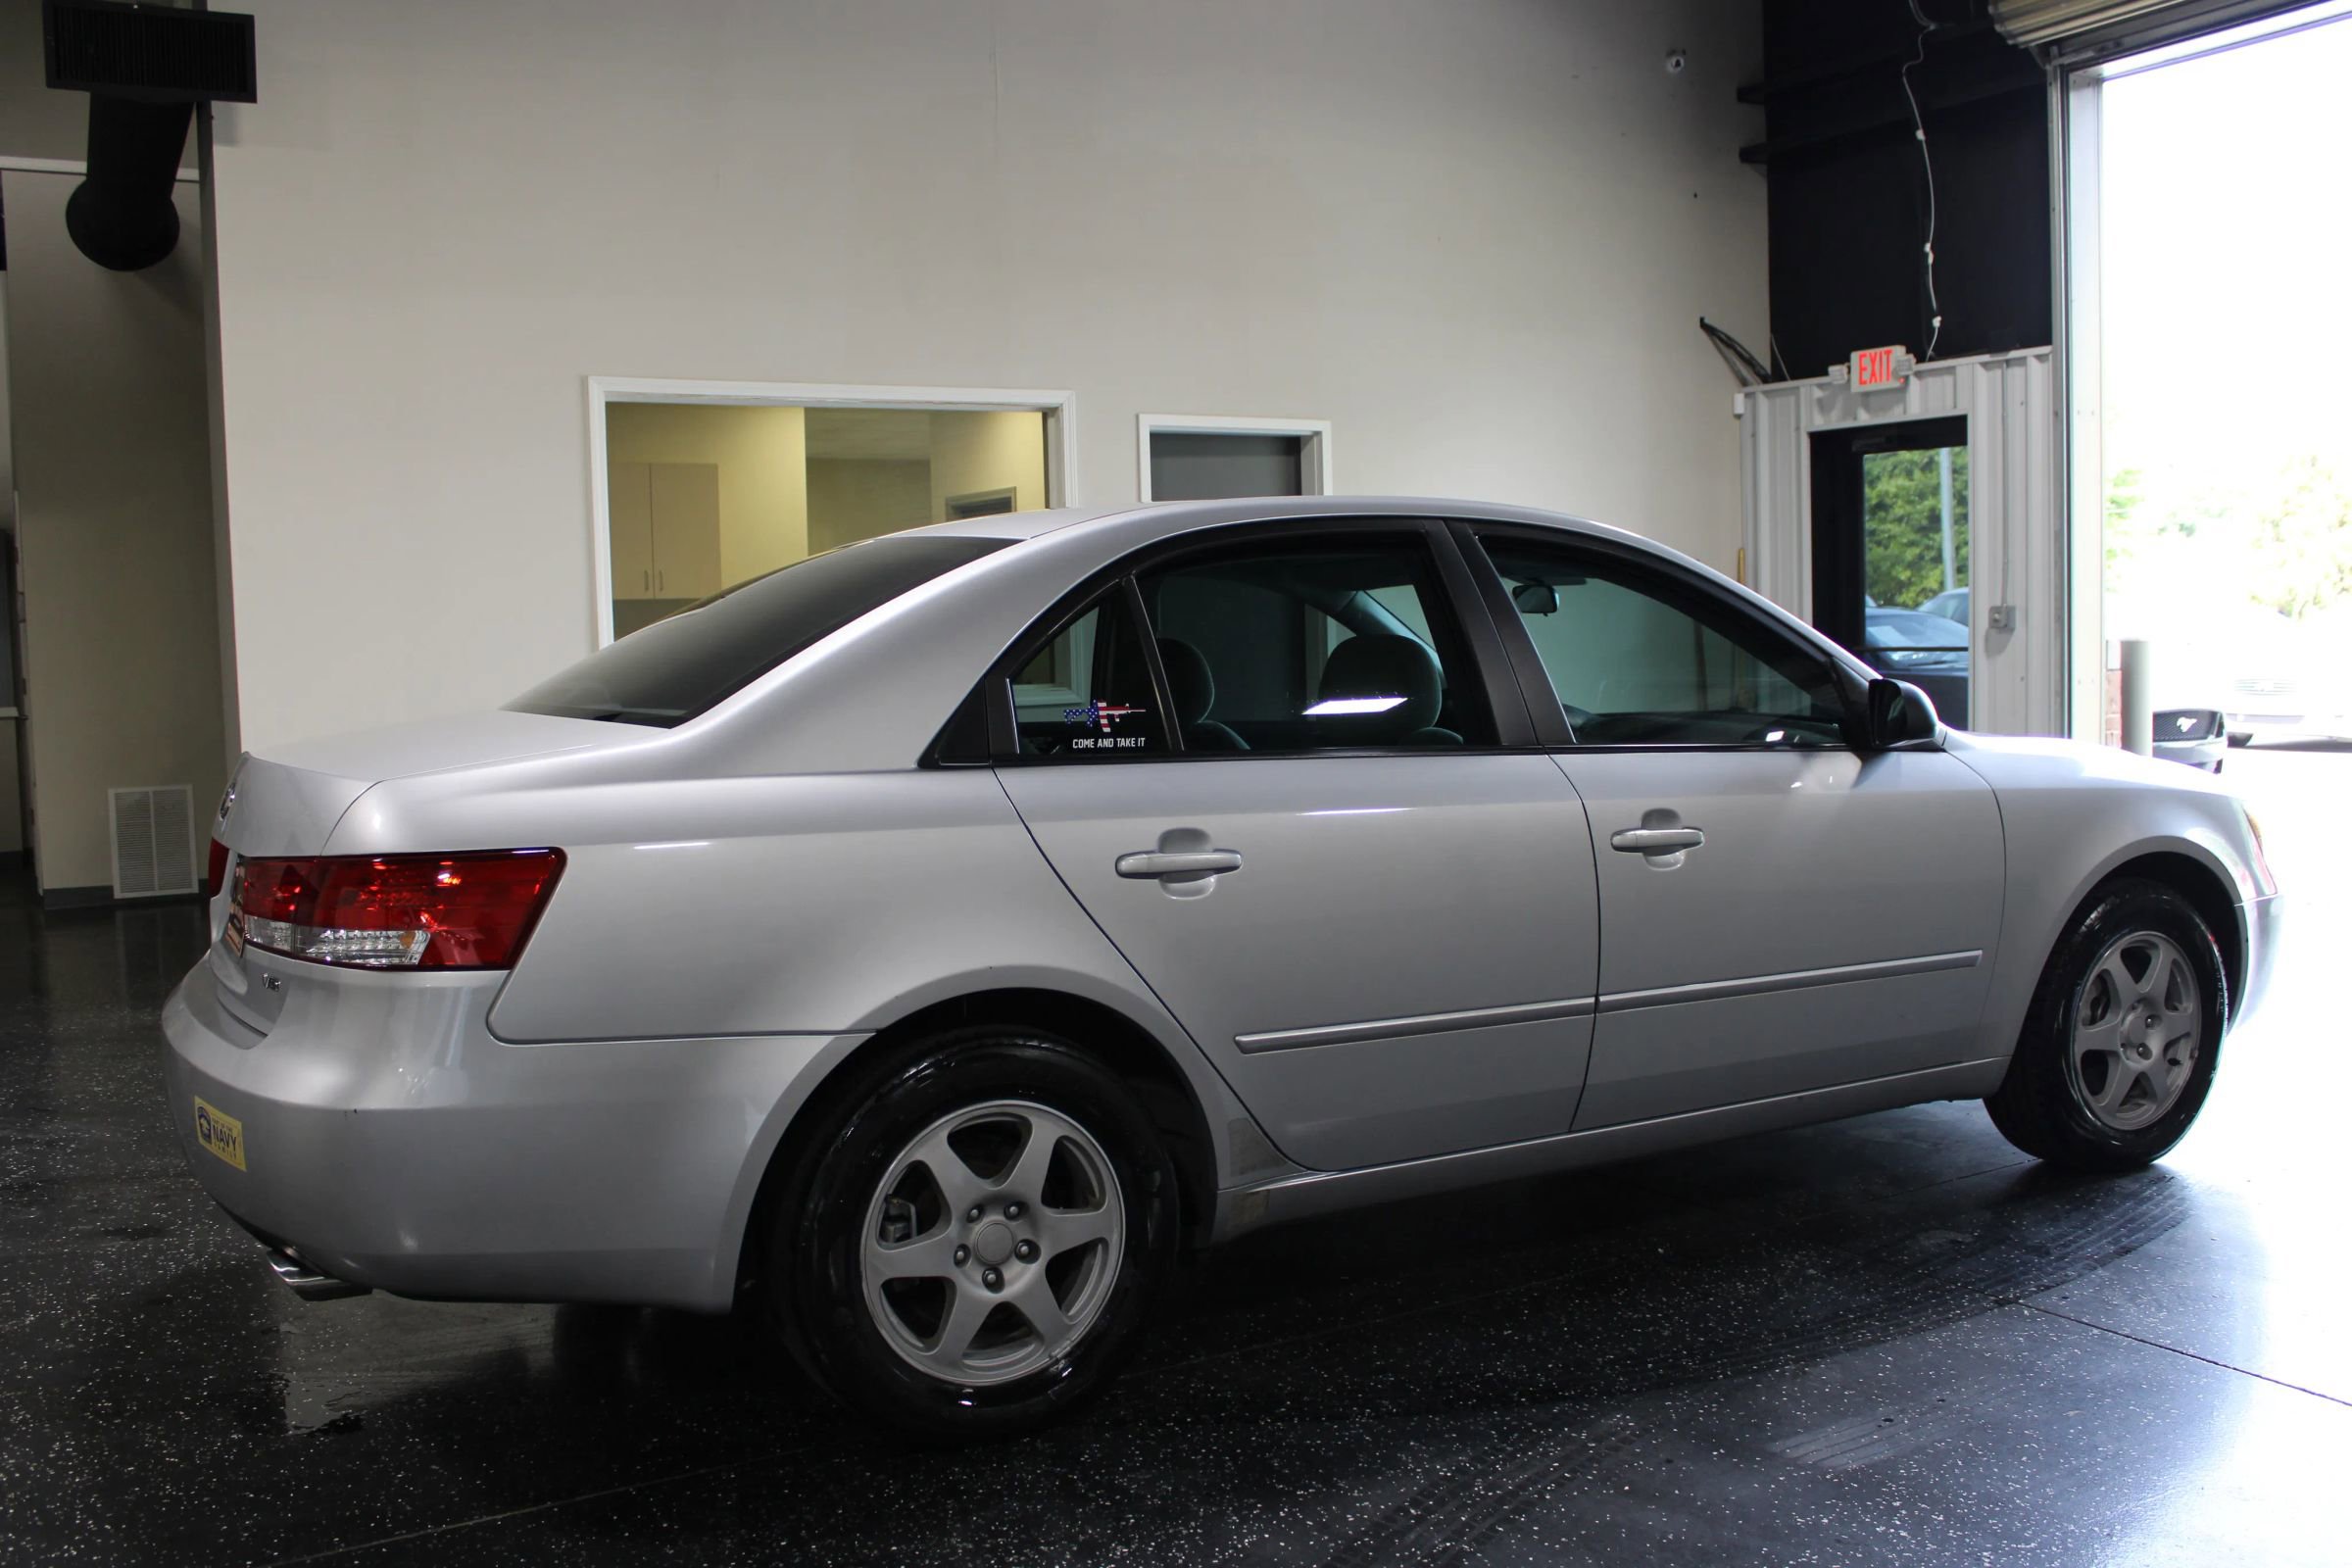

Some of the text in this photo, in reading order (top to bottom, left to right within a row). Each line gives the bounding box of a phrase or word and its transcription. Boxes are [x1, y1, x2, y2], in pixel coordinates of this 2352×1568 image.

[1858, 348, 1893, 386] EXIT
[1073, 737, 1146, 749] COME AND TAKE IT
[213, 1124, 237, 1152] NAVY
